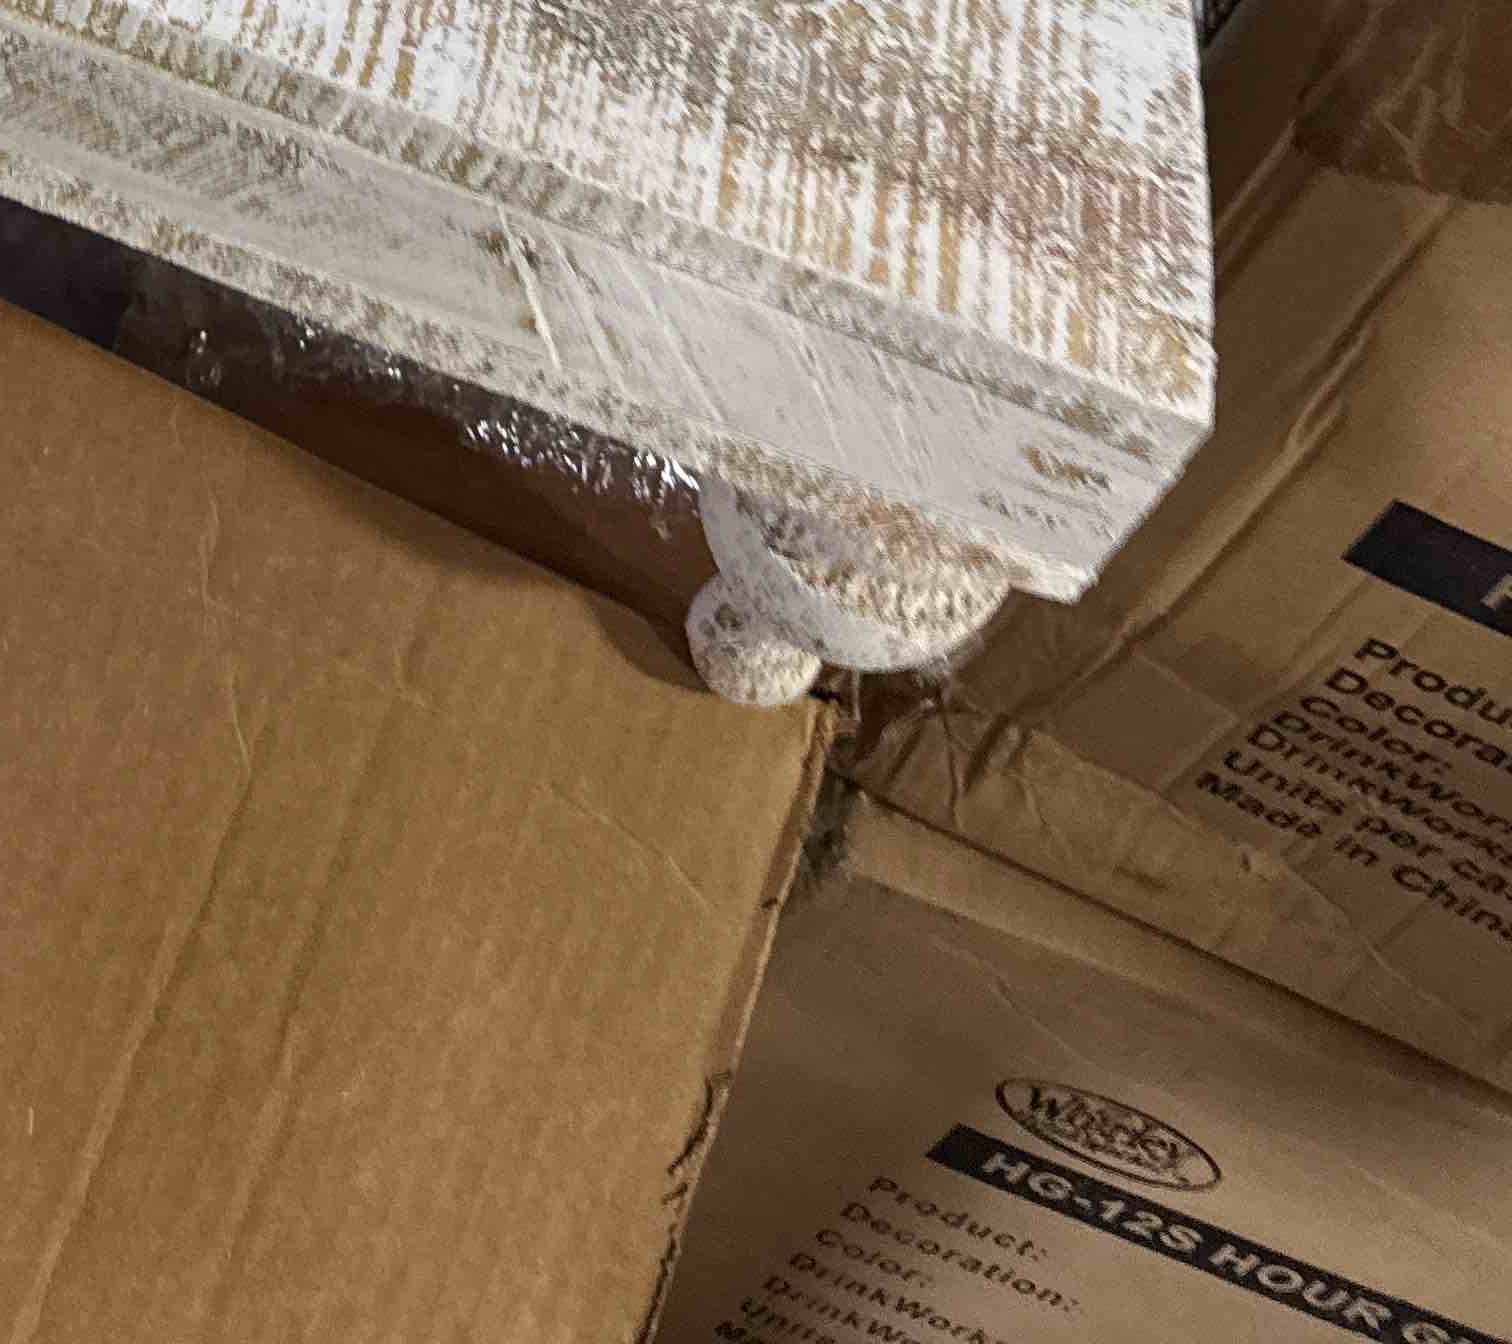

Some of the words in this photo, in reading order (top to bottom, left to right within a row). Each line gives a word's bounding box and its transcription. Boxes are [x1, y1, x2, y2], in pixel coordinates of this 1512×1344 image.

[1325, 667, 1512, 775] Decora
[1354, 638, 1512, 729] Produ
[1272, 710, 1512, 835] DrinkWor
[1335, 834, 1380, 867] in
[815, 1227, 934, 1289] Color:
[841, 1201, 1081, 1313] Decoration:
[869, 1175, 1049, 1262] Product:
[982, 1150, 1205, 1256] HG-12S
[1209, 1242, 1391, 1332] HOUR
[789, 1252, 1008, 1344] DrinkWork
